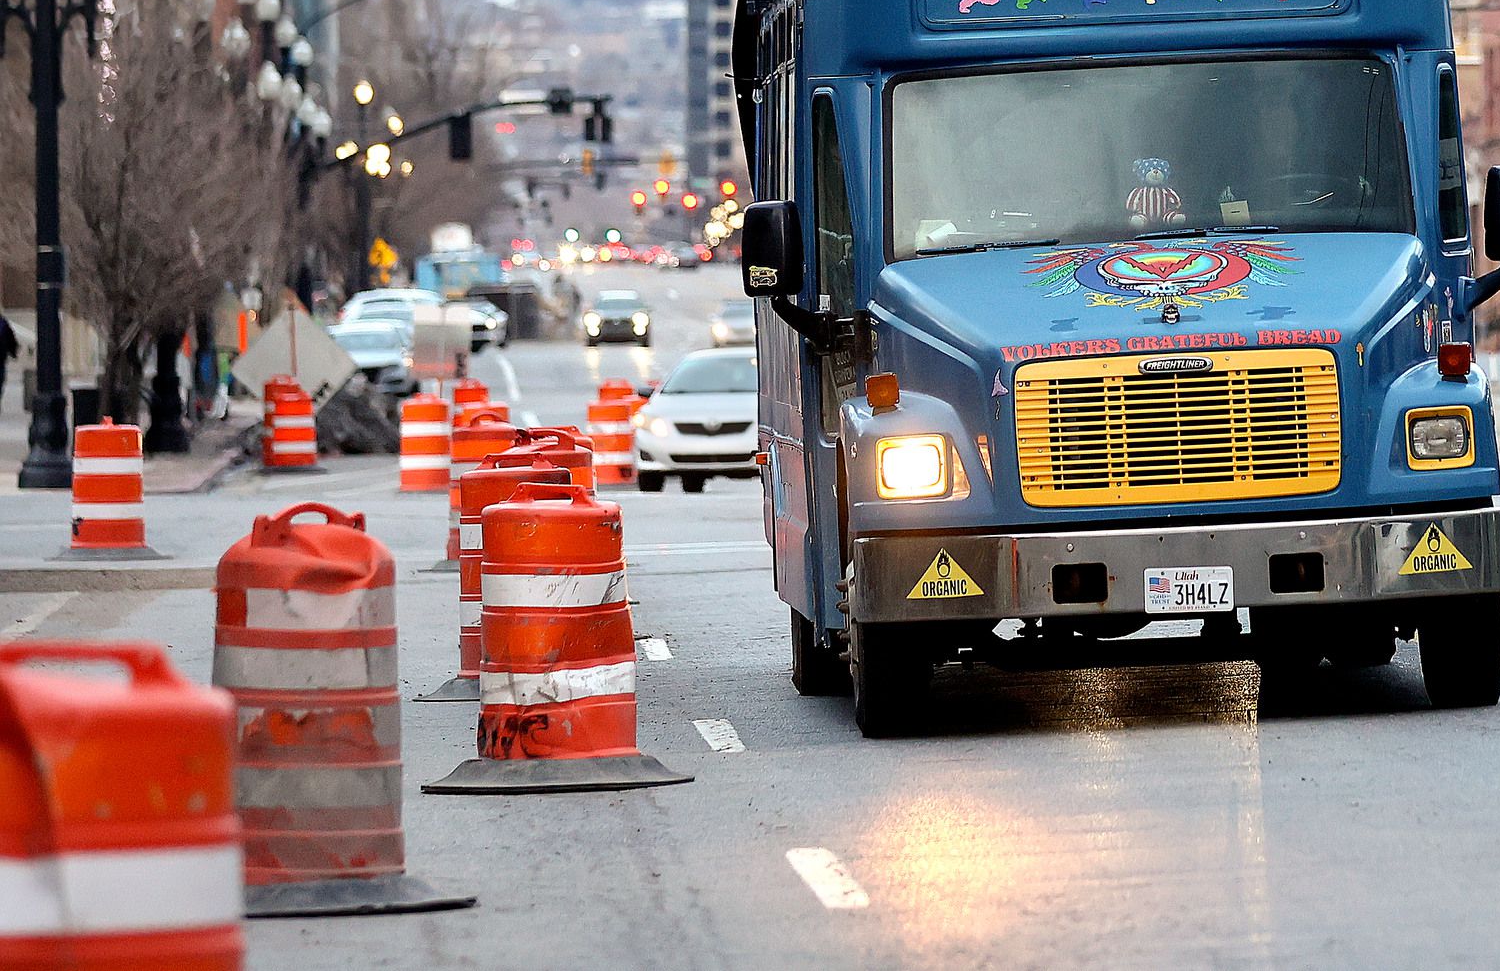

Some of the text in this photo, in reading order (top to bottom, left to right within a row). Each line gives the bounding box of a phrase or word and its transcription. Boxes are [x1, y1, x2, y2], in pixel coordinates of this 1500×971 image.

[1001, 328, 1342, 363] VOLKERS GRATEFUL BREAD
[1146, 359, 1205, 370] FREIGHTLINER
[1413, 553, 1457, 572] ORGANIC
[1175, 570, 1199, 581] Utah
[922, 579, 967, 597] ORGANIC
[1174, 582, 1229, 606] 3H4LZ
